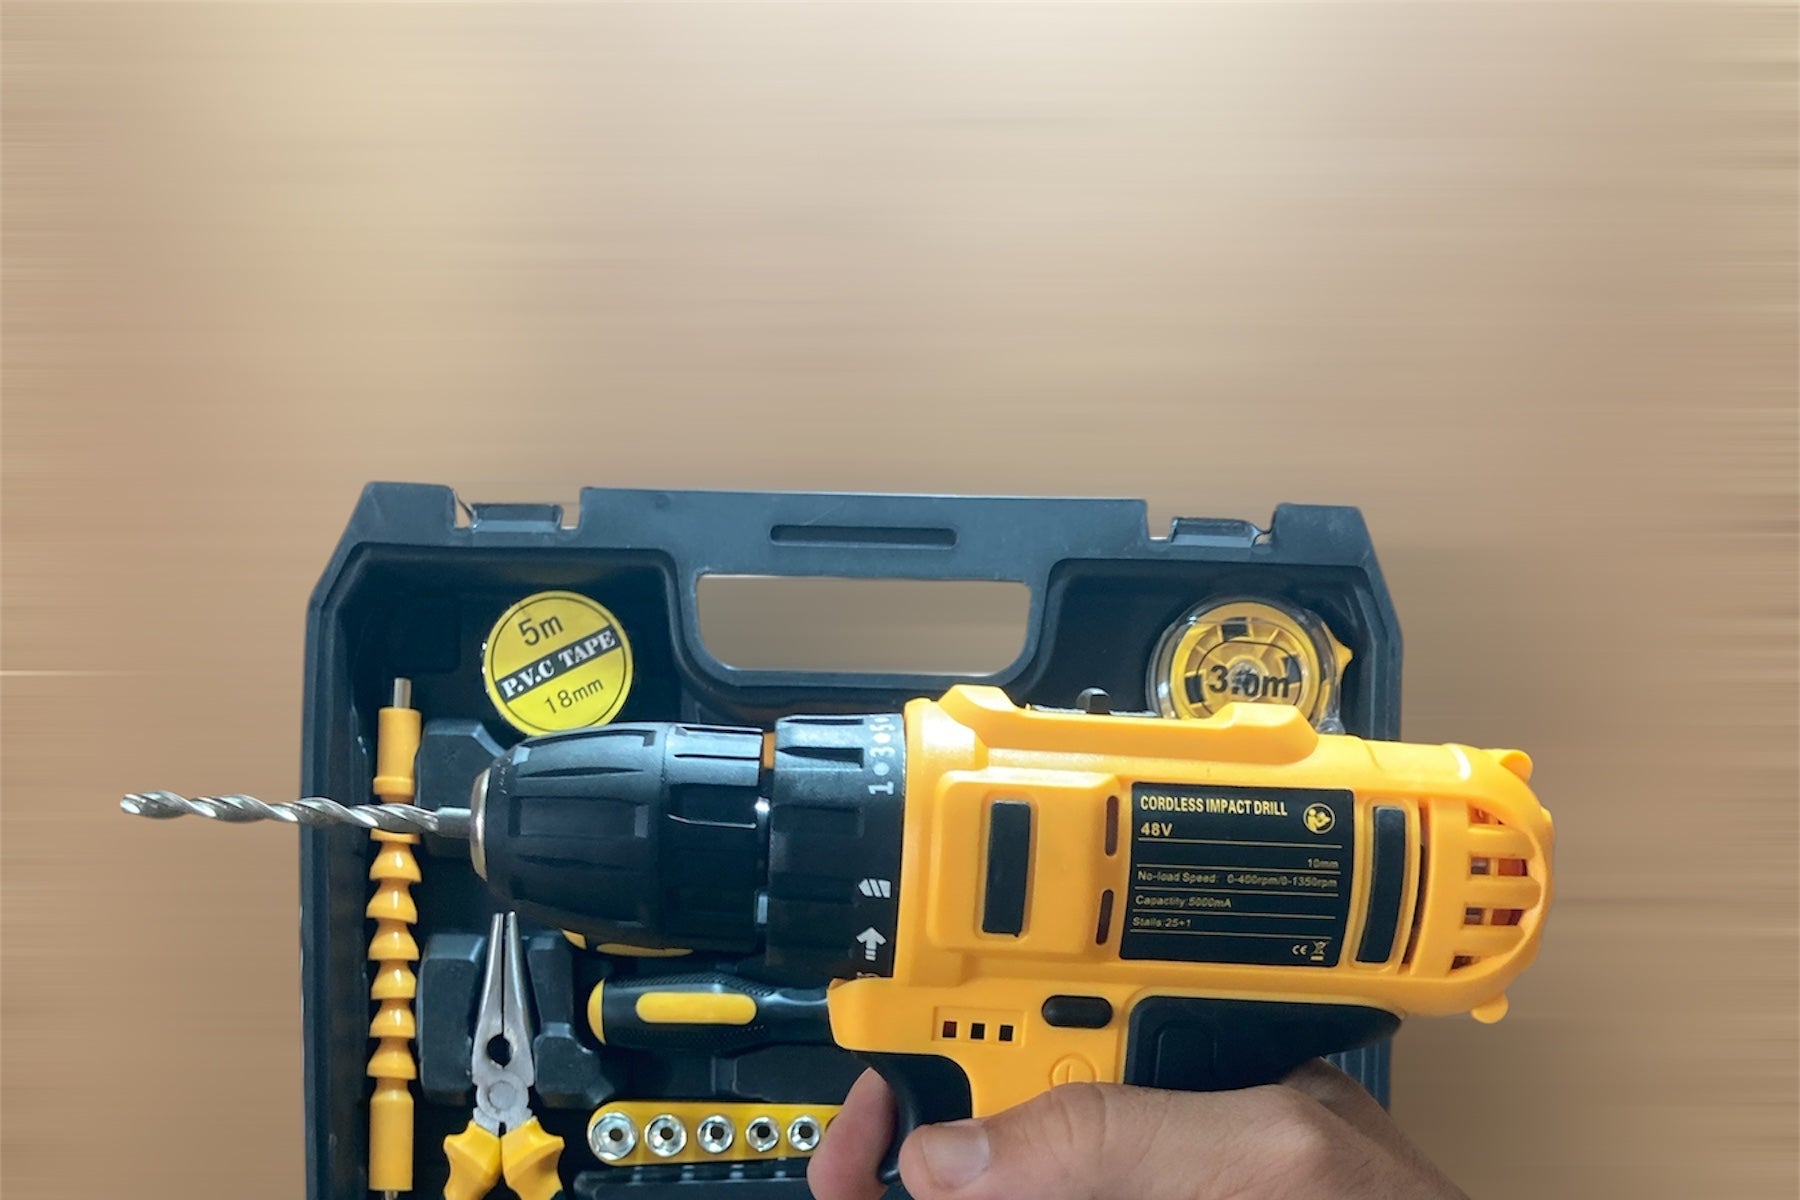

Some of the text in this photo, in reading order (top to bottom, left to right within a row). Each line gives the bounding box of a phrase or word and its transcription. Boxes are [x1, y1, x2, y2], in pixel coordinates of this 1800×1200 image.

[518, 615, 564, 646] 5m
[558, 630, 616, 667] TAPE
[1208, 664, 1289, 698] 3.0m
[544, 678, 604, 714] 18mm
[1140, 796, 1288, 816] CORDLESS IMPACT DRILL
[1140, 823, 1172, 837] 48V
[1137, 870, 1181, 882] No-load
[1307, 858, 1339, 869] 10mm
